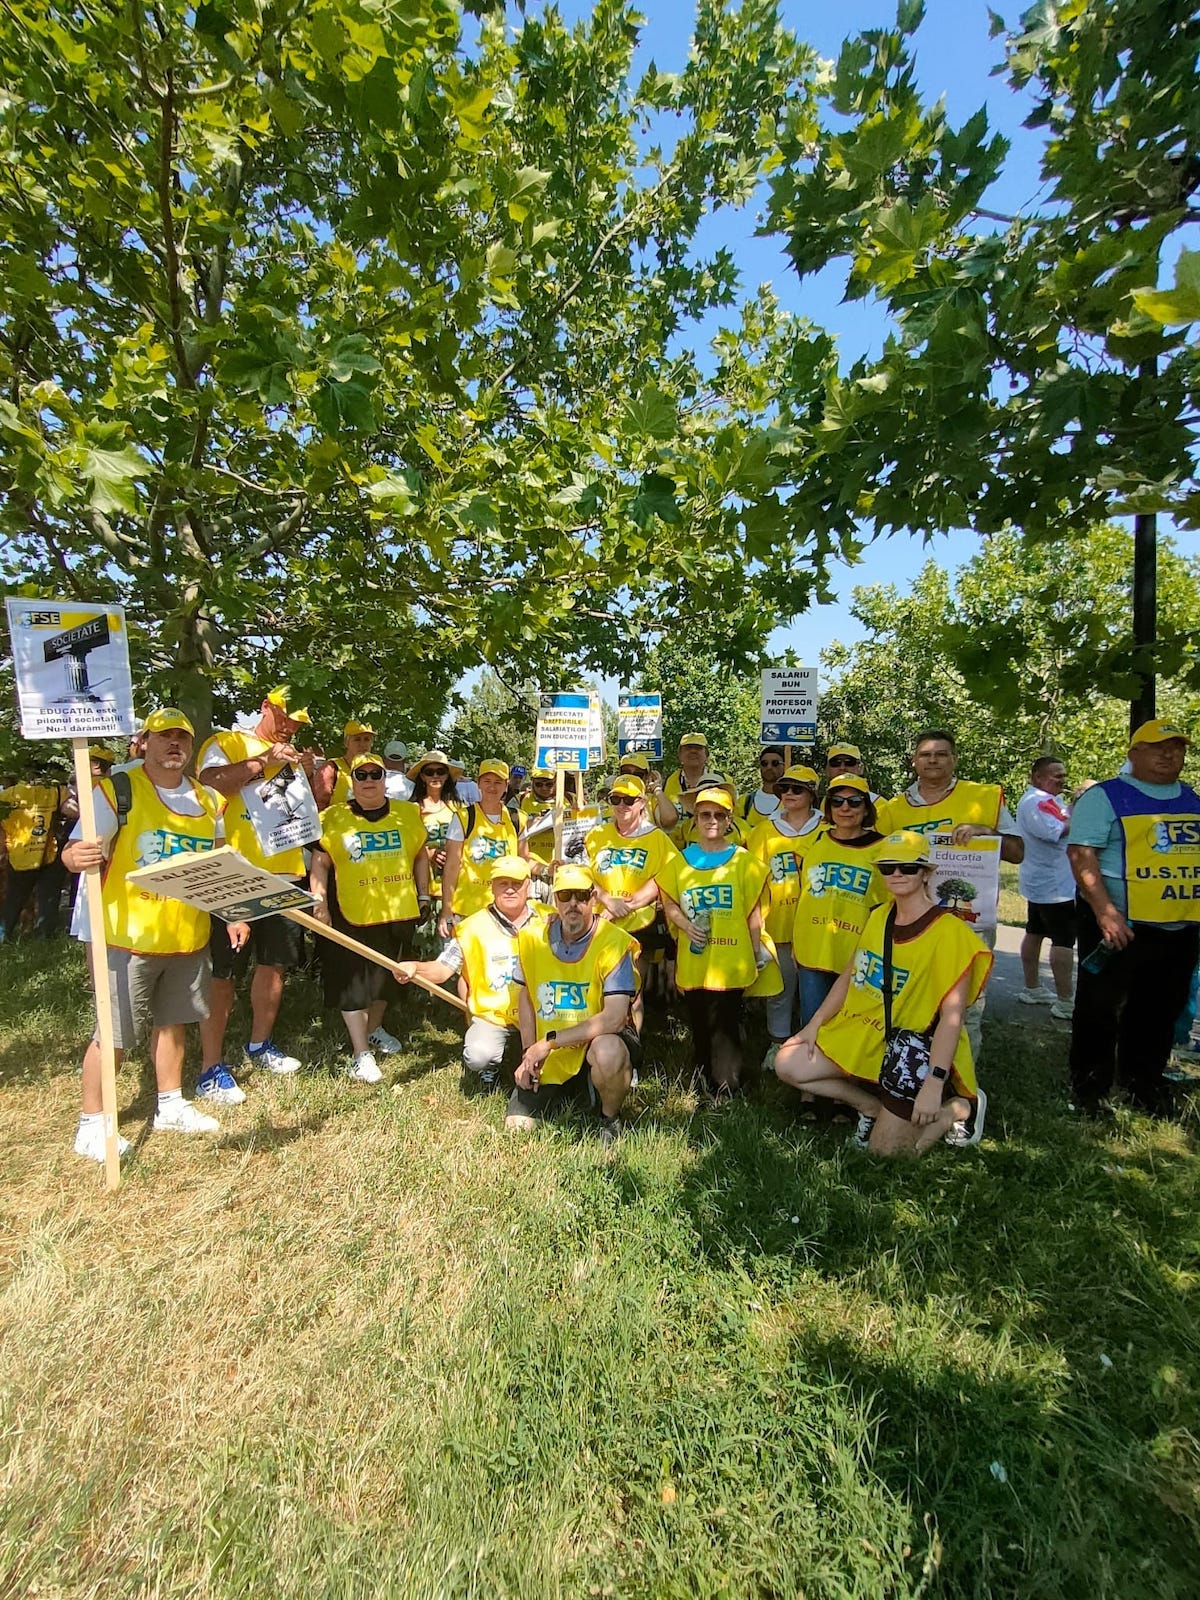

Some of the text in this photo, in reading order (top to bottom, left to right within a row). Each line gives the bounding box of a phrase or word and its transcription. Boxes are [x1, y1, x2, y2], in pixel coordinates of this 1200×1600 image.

[31, 612, 60, 624] FSE
[51, 621, 101, 649] SOCIETATE
[771, 671, 810, 679] SALARIU
[36, 717, 72, 726] pilonul
[46, 725, 67, 733] Nu-l
[796, 726, 814, 735] FSE
[635, 741, 655, 751] FSE
[557, 750, 580, 762] FSE
[589, 750, 600, 758] SE
[1168, 822, 1200, 843] FS
[164, 833, 213, 855] FSE
[360, 830, 401, 849] FSE
[935, 851, 982, 863] Educația
[150, 861, 222, 882] SALARIU
[183, 870, 220, 883] BUN
[383, 872, 412, 883] SIBIU
[826, 864, 870, 891] FSE
[184, 875, 267, 900] PROFESOR
[201, 883, 267, 904] MOTIVAT
[691, 886, 731, 907] FSE
[832, 918, 863, 936] SIBIU
[710, 937, 738, 946] SIBIU
[866, 956, 909, 992] FE
